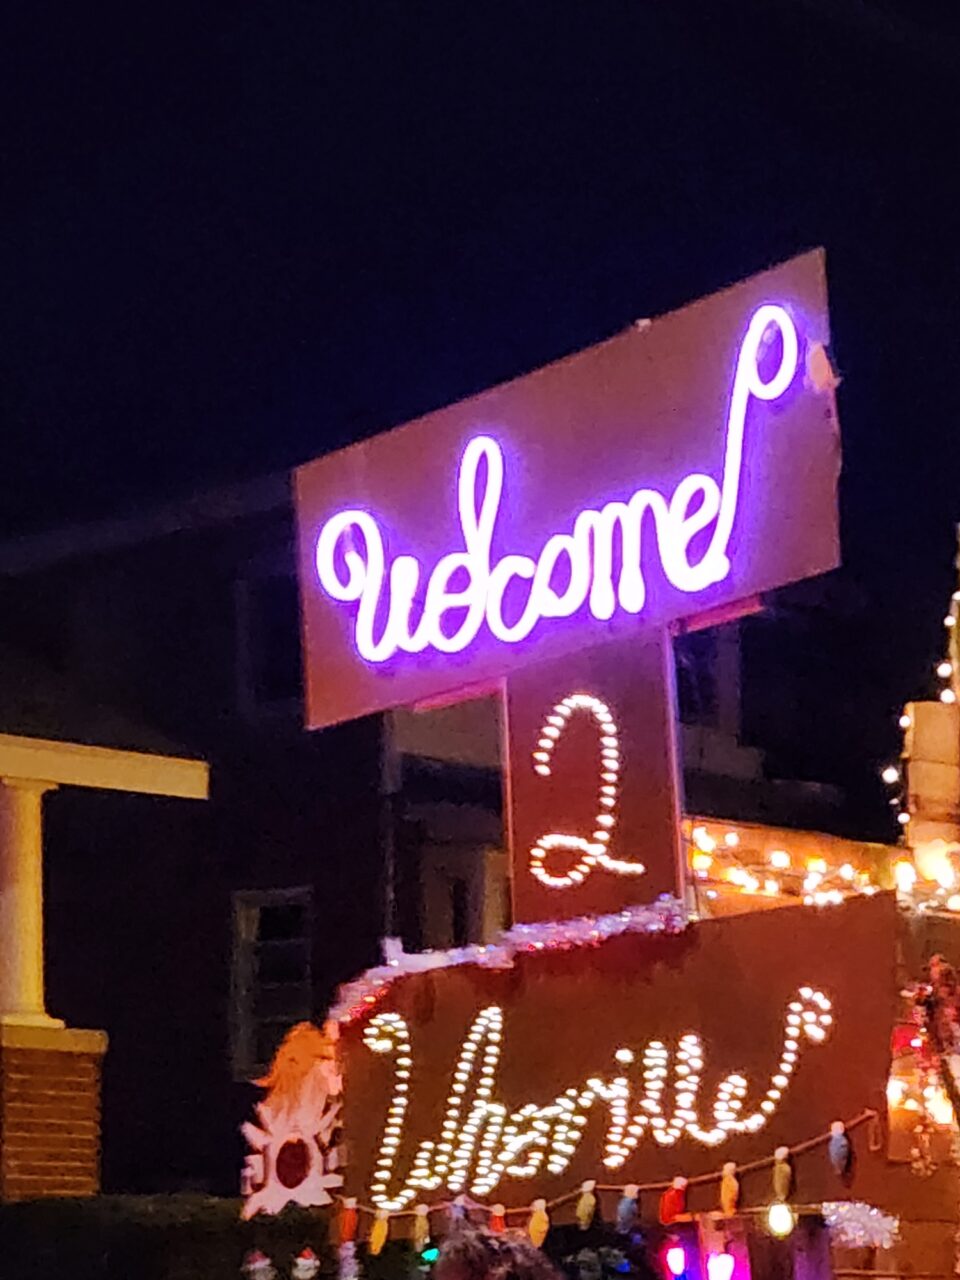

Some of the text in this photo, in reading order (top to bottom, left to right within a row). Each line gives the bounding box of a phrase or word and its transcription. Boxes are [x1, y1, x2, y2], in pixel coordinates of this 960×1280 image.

[316, 304, 798, 662] Welcome
[530, 693, 645, 888] 2
[362, 986, 833, 1210] Whoville
